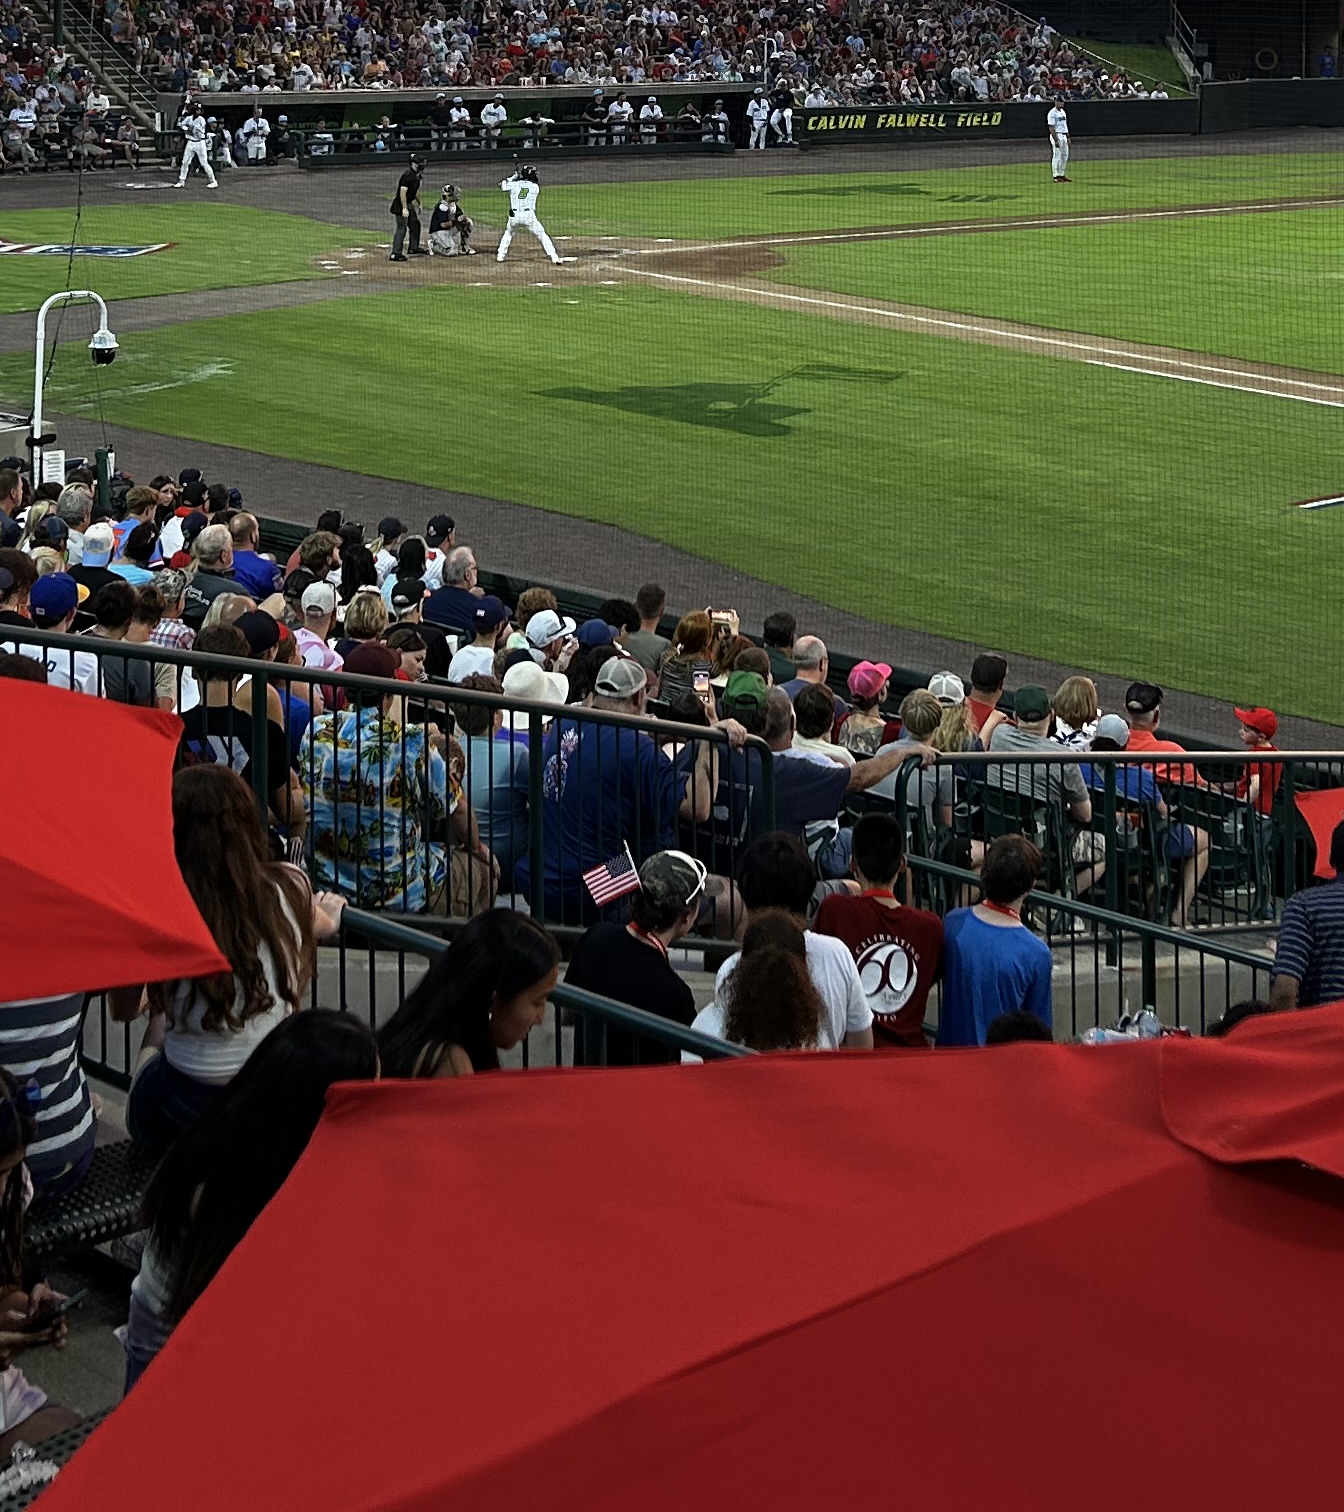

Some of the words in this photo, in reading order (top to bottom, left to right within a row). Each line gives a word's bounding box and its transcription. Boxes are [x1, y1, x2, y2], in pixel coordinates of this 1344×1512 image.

[806, 114, 867, 131] CALVIN
[875, 113, 947, 129] FALWELL
[957, 112, 1003, 127] FIELD
